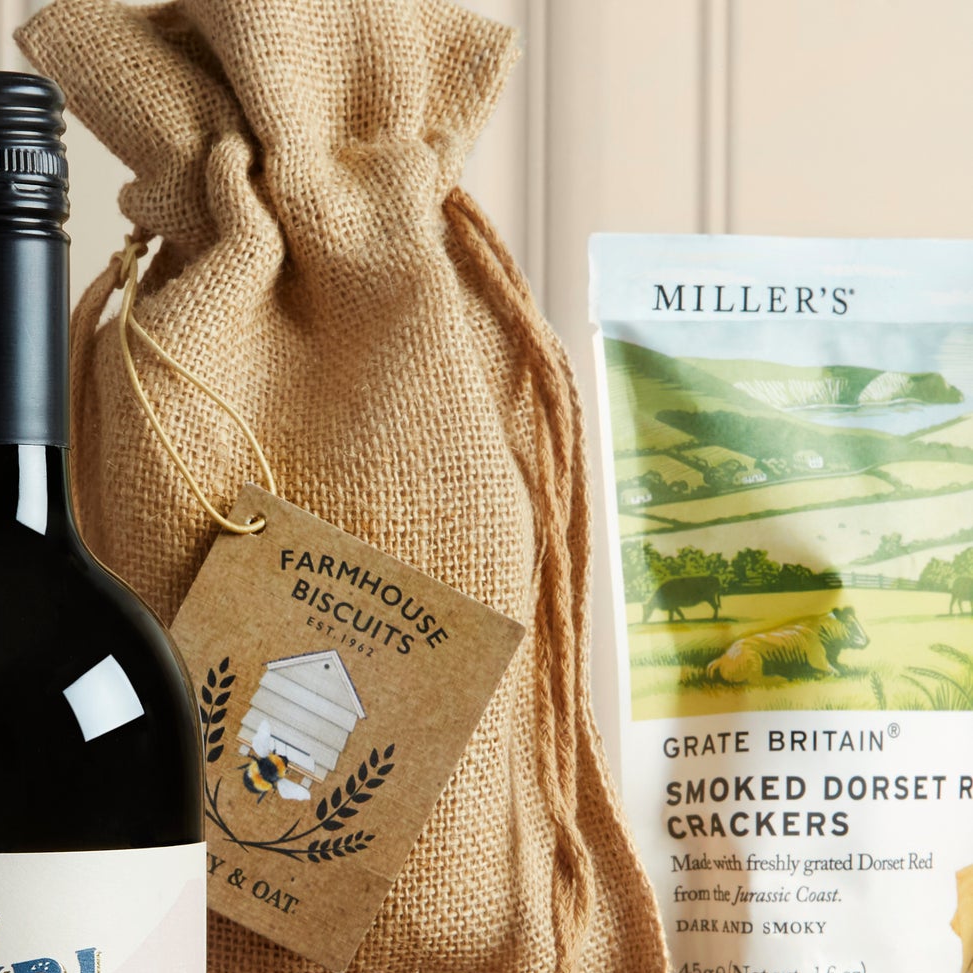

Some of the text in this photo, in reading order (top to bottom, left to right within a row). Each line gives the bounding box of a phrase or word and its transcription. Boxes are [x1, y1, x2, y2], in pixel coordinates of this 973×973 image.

[280, 549, 449, 649] FARMHOUSE
[291, 578, 415, 655] BISCUITS
[340, 634, 374, 657] 1962
[663, 731, 750, 758] GRATE
[665, 776, 807, 806] SMOKED
[823, 775, 947, 801] DORSET
[667, 811, 850, 840] CRACKERS
[670, 851, 933, 877] Made with freshly grated Dorset Red
[227, 867, 247, 890] &
[673, 883, 842, 906] from the Jurassic Coast.
[675, 919, 827, 935] DARK AND SMOKY
